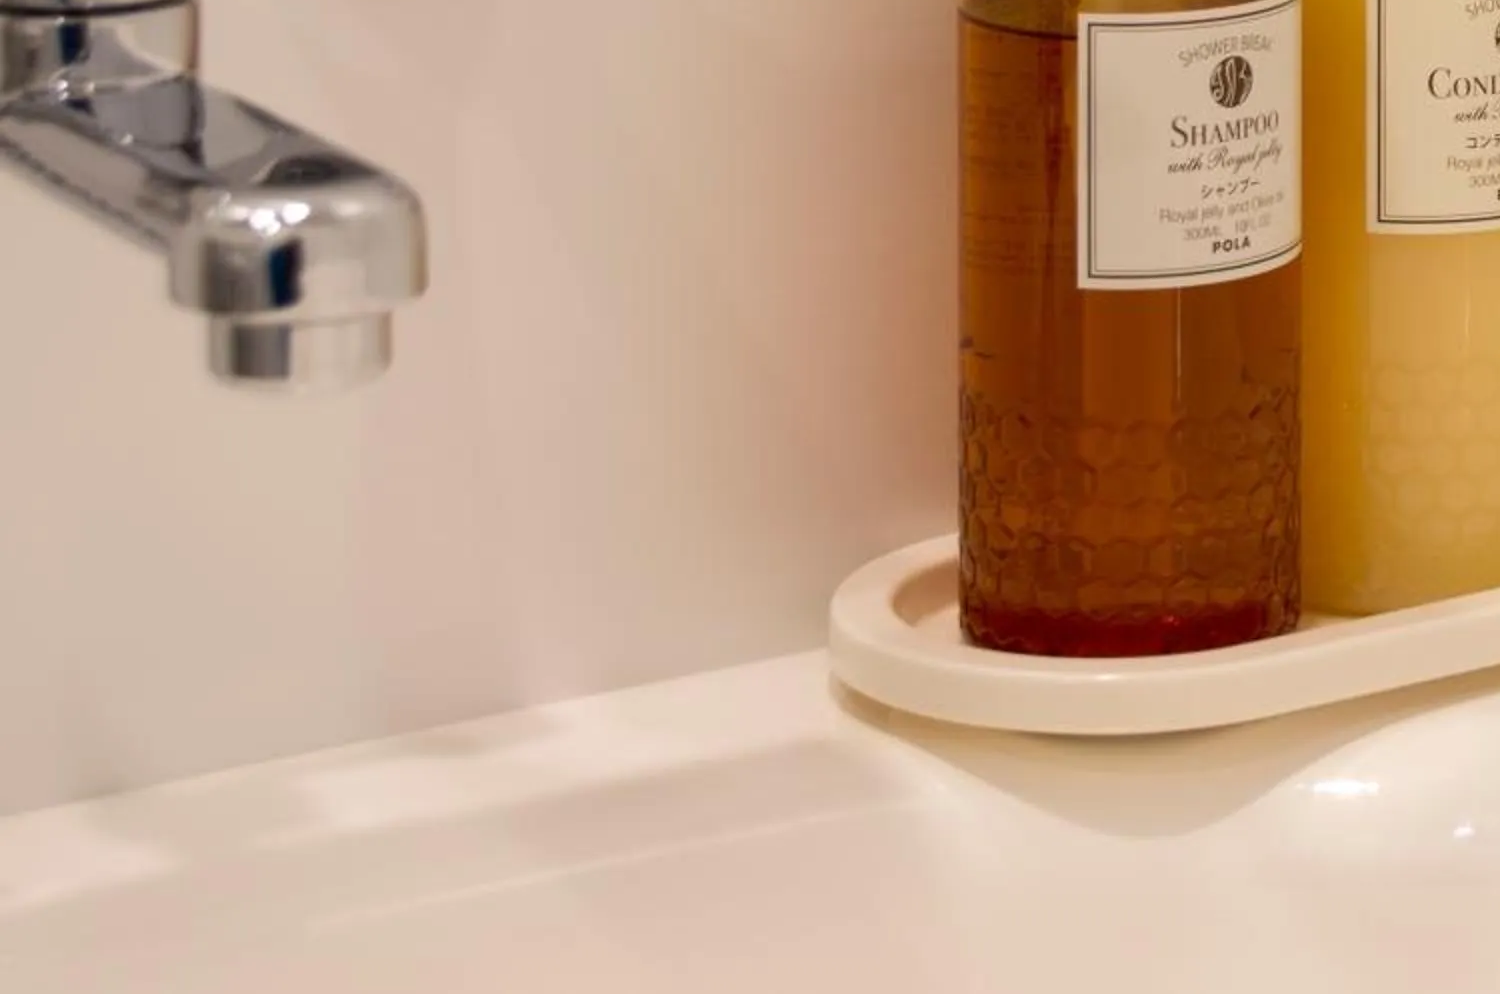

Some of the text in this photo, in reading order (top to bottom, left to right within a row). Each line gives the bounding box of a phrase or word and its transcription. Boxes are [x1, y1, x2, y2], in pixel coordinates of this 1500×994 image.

[1178, 35, 1239, 67] SHOWER
[1454, 101, 1489, 122] with
[1170, 109, 1280, 148] SHAMPOO
[1168, 152, 1203, 174] with
[1206, 143, 1261, 174] Royal
[1201, 177, 1261, 198] シャンプー
[1212, 236, 1251, 254] POLA
